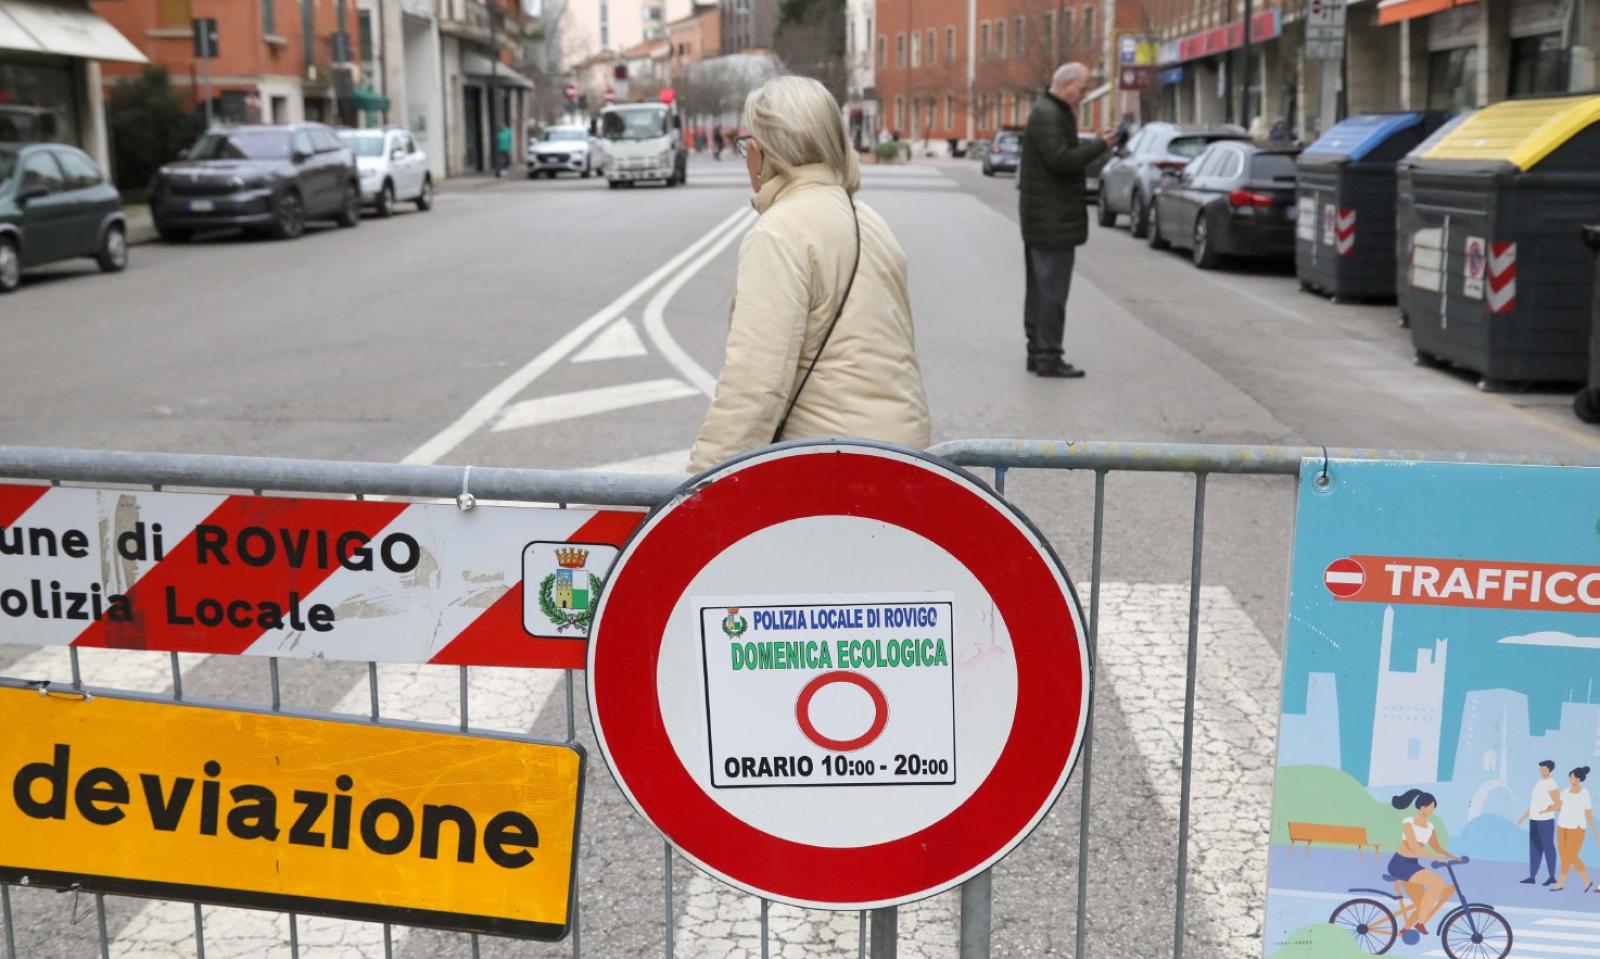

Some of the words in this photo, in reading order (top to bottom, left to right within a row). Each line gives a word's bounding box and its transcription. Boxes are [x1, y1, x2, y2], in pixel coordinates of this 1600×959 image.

[116, 521, 164, 562] di
[196, 524, 421, 573] ROVIGO
[165, 586, 335, 632] Locale
[753, 610, 806, 630] POLIZIA
[810, 608, 863, 629] LOCALE
[866, 608, 881, 628] DI
[884, 606, 938, 628] ROVIGO
[731, 641, 832, 670] DOMENICA
[836, 638, 948, 668] ECOLOGICA
[724, 755, 814, 778] ORARIO
[821, 755, 875, 776] 10:00
[893, 754, 948, 776] 20:00
[12, 743, 540, 869] deviazione
